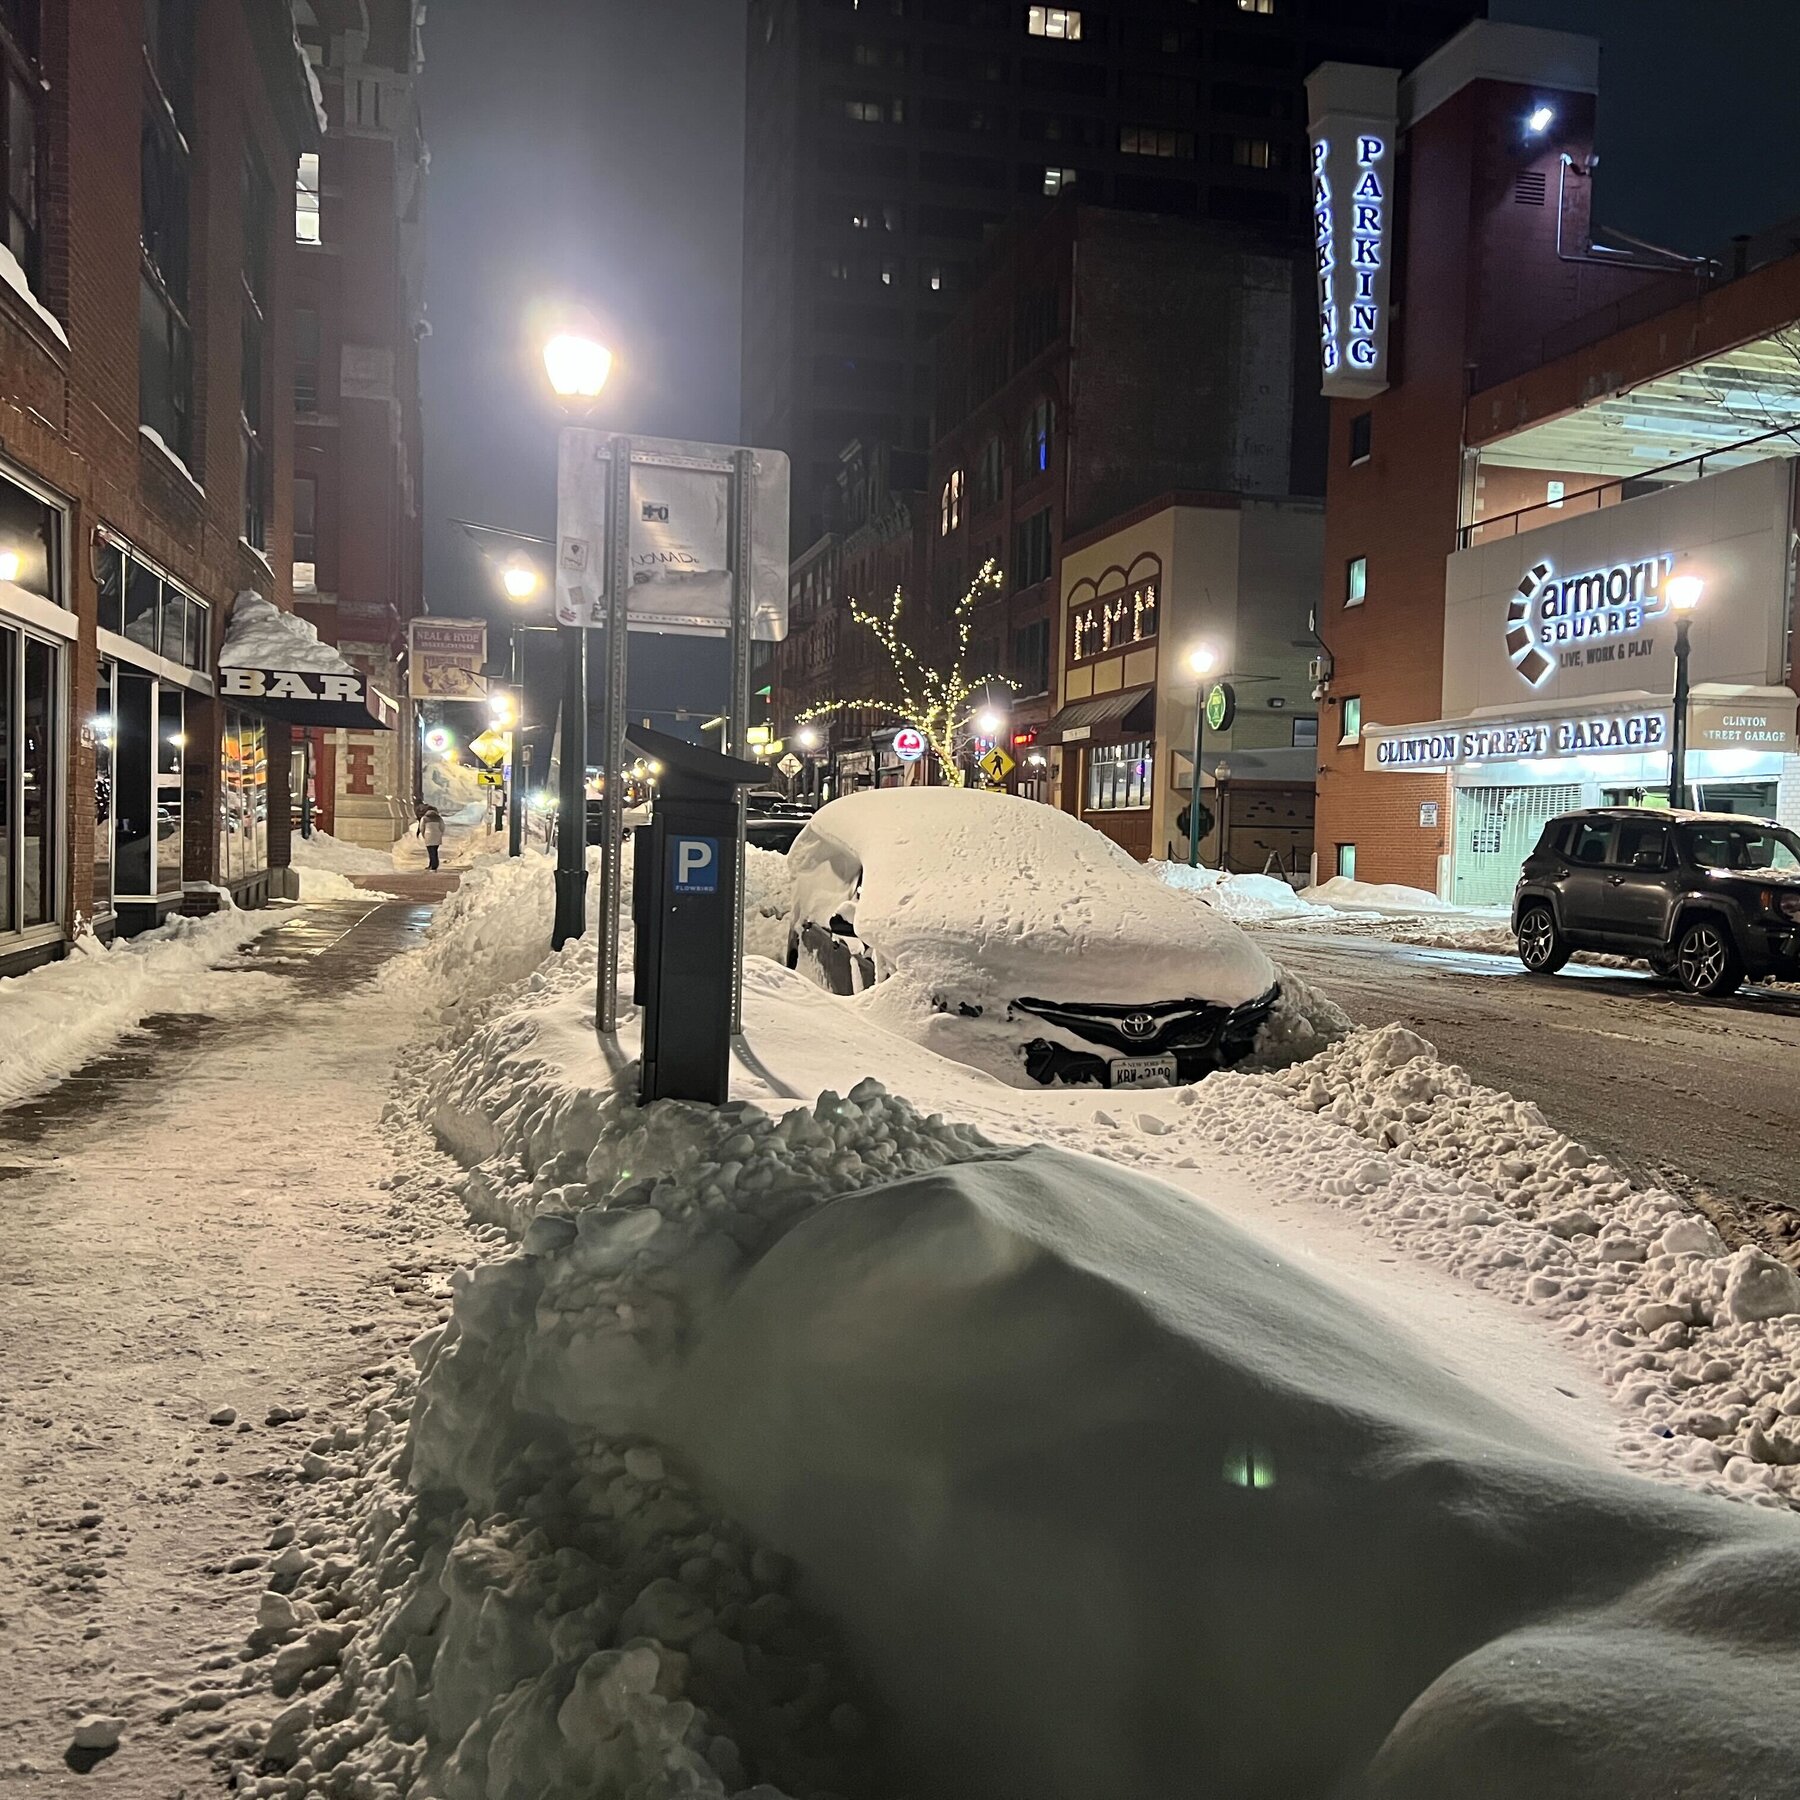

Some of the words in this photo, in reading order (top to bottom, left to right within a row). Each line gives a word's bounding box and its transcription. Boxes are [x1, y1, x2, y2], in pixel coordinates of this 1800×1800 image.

[1312, 142, 1336, 370] PARKING
[1351, 137, 1383, 365] PARKING
[1540, 557, 1669, 619] armory
[416, 631, 441, 641] NEAL
[443, 632, 451, 641] &
[453, 632, 479, 643] HYDE
[1540, 607, 1639, 643] SQUARE
[1560, 650, 1584, 668] LIVE,
[1586, 645, 1615, 664] WORK
[1617, 643, 1626, 659] &
[1628, 639, 1654, 658] PLAY
[220, 667, 365, 703] BAR
[1376, 735, 1456, 763] CLINTON
[1462, 727, 1548, 756] STREET
[1557, 716, 1662, 750] GARAGE
[1703, 730, 1742, 741] STREET
[1744, 731, 1786, 742] GARAGE
[1722, 716, 1767, 727] CLINTON
[678, 841, 712, 883] P
